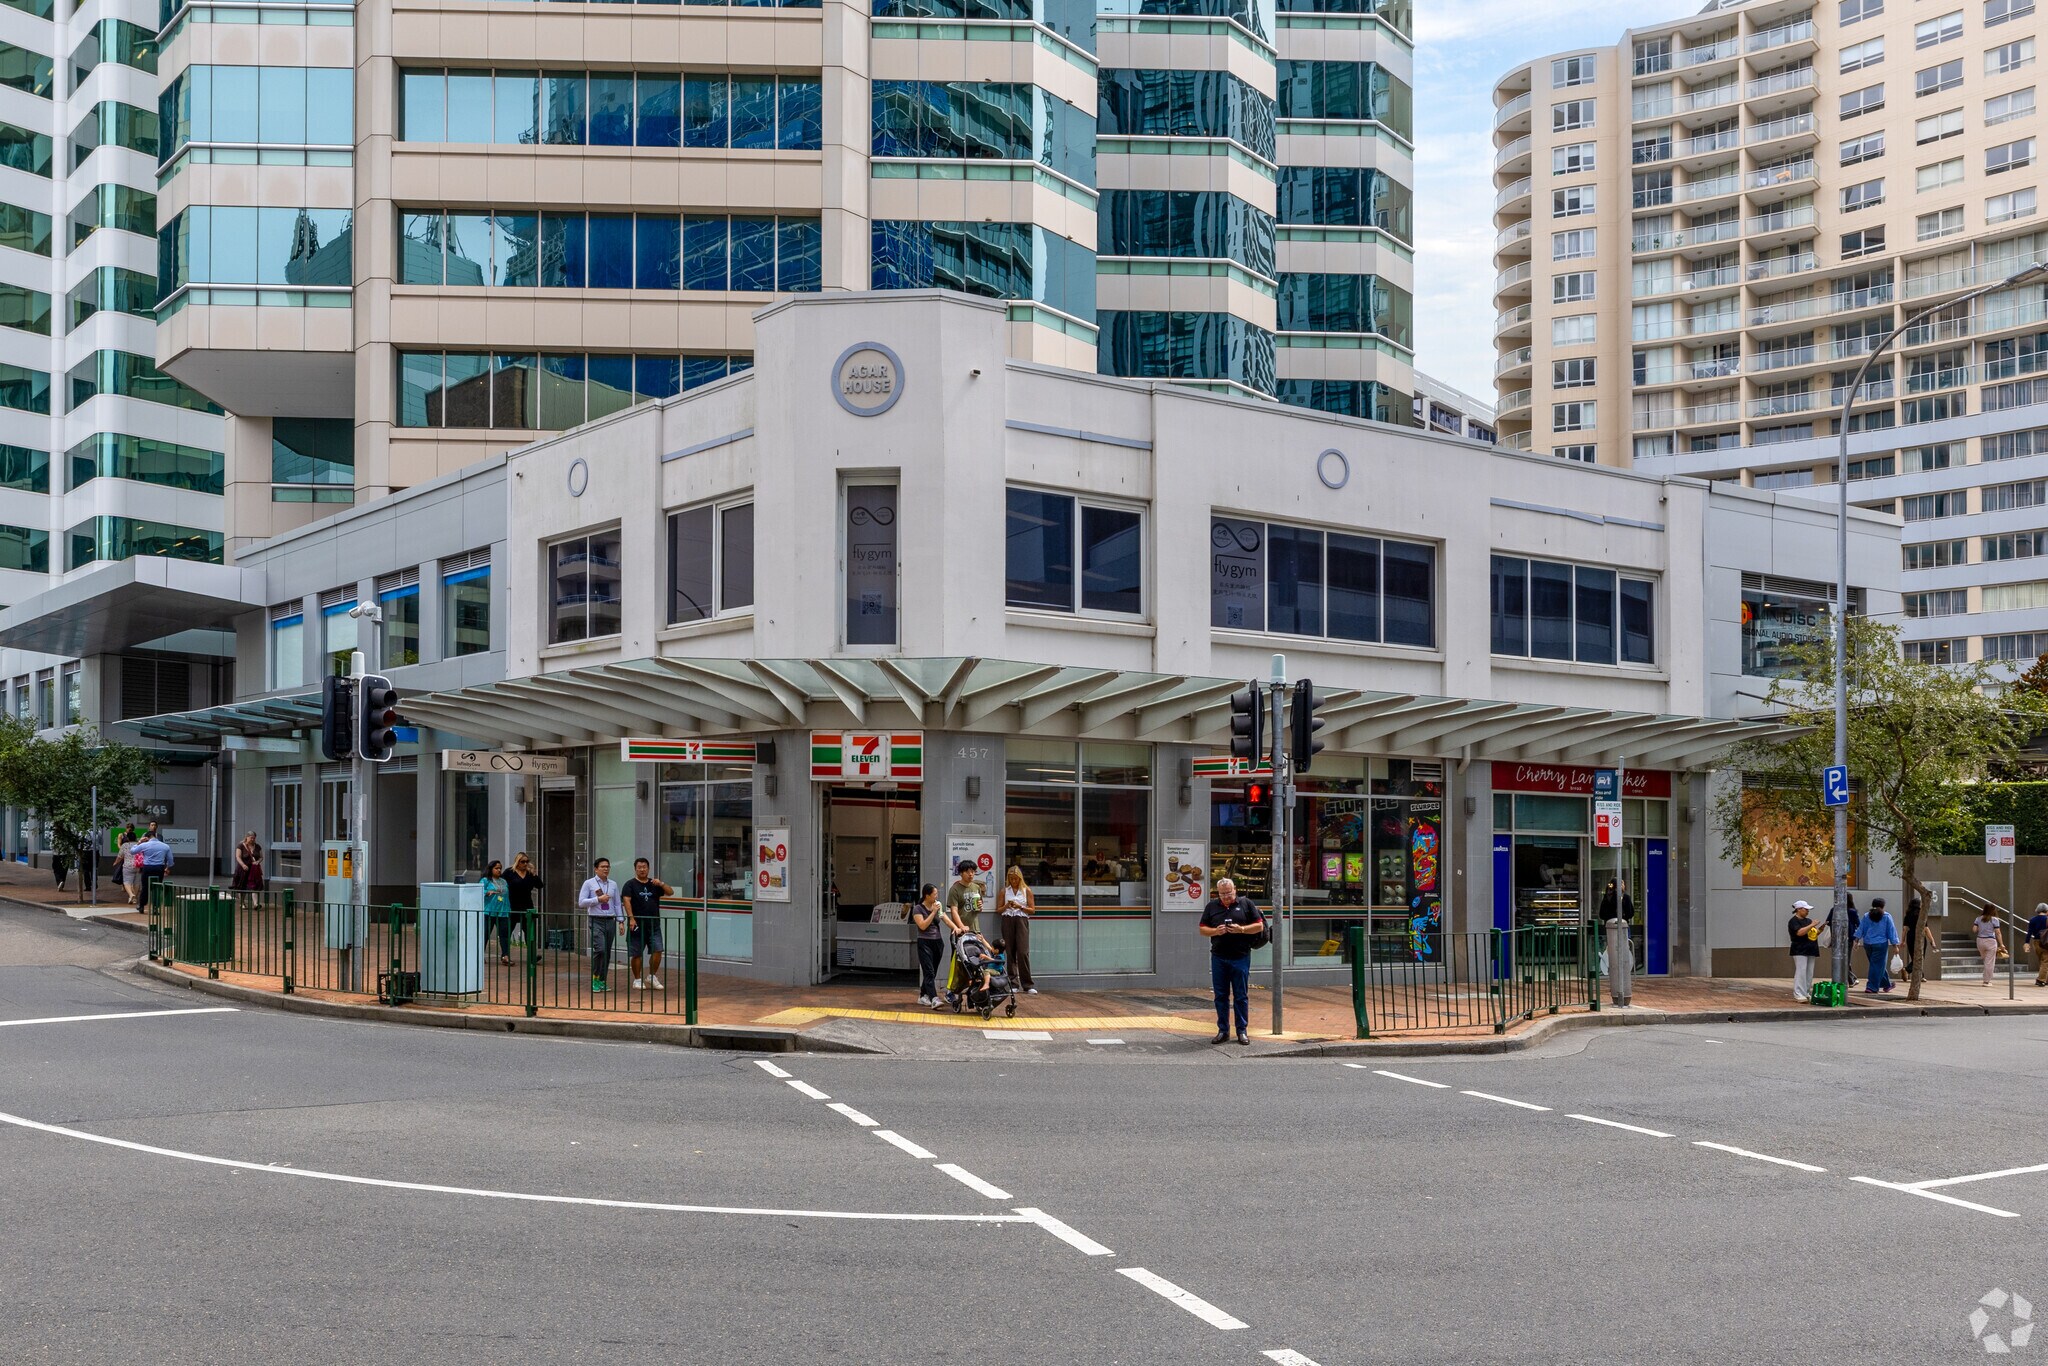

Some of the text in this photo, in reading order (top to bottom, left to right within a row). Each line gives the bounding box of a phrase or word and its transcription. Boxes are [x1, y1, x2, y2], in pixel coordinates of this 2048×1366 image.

[849, 365, 888, 379] AGAR
[843, 379, 891, 394] HOUSE
[957, 747, 989, 759] 457
[1516, 765, 1567, 790] Cherry
[1571, 770, 1594, 785] Lan
[1829, 770, 1841, 789] P
[1325, 798, 1399, 817] SLUREE
[1411, 802, 1440, 811] SLURPEE
[980, 858, 989, 866] $6
